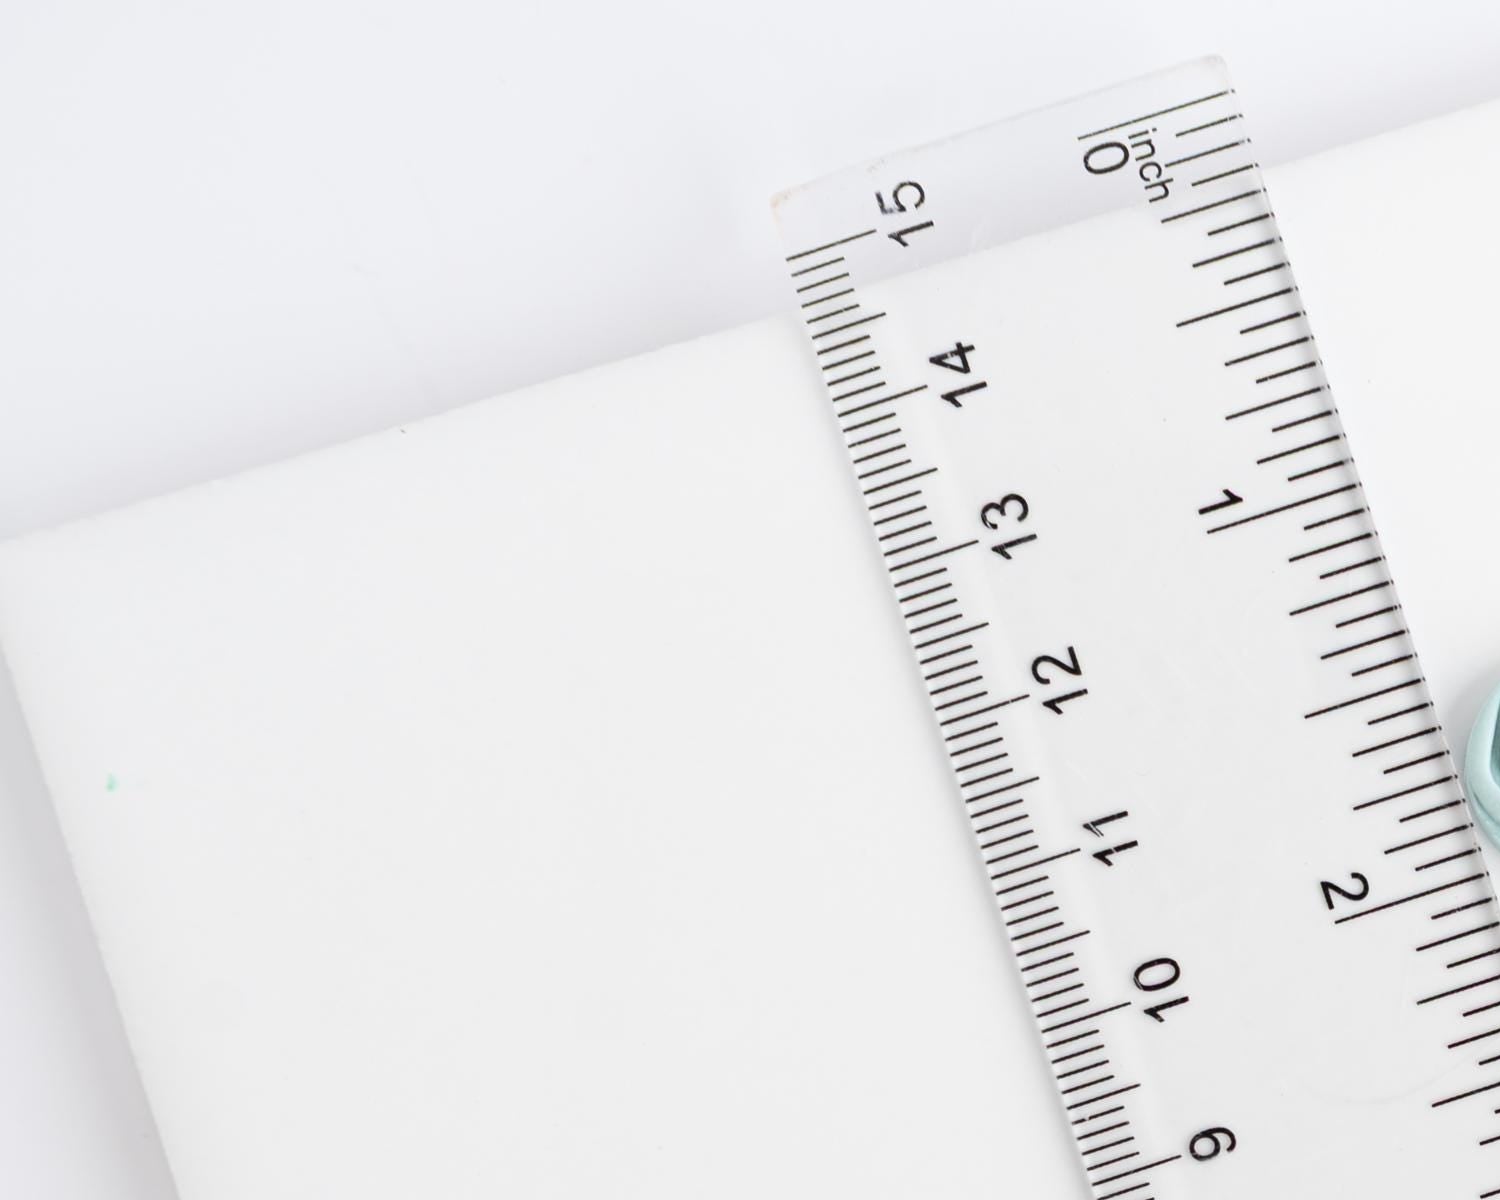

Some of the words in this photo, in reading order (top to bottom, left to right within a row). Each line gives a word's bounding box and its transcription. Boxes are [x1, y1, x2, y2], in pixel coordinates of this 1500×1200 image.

[1083, 141, 1130, 175] 0
[1127, 127, 1175, 204] inch
[877, 180, 934, 248] 15
[929, 342, 988, 408] 14
[980, 493, 1038, 560] 13
[1198, 488, 1244, 515] 1
[1031, 646, 1089, 715] 12
[1084, 806, 1139, 867] 11
[1319, 872, 1370, 911] 2
[1132, 957, 1190, 1023] 10
[1188, 1126, 1237, 1162] 9
